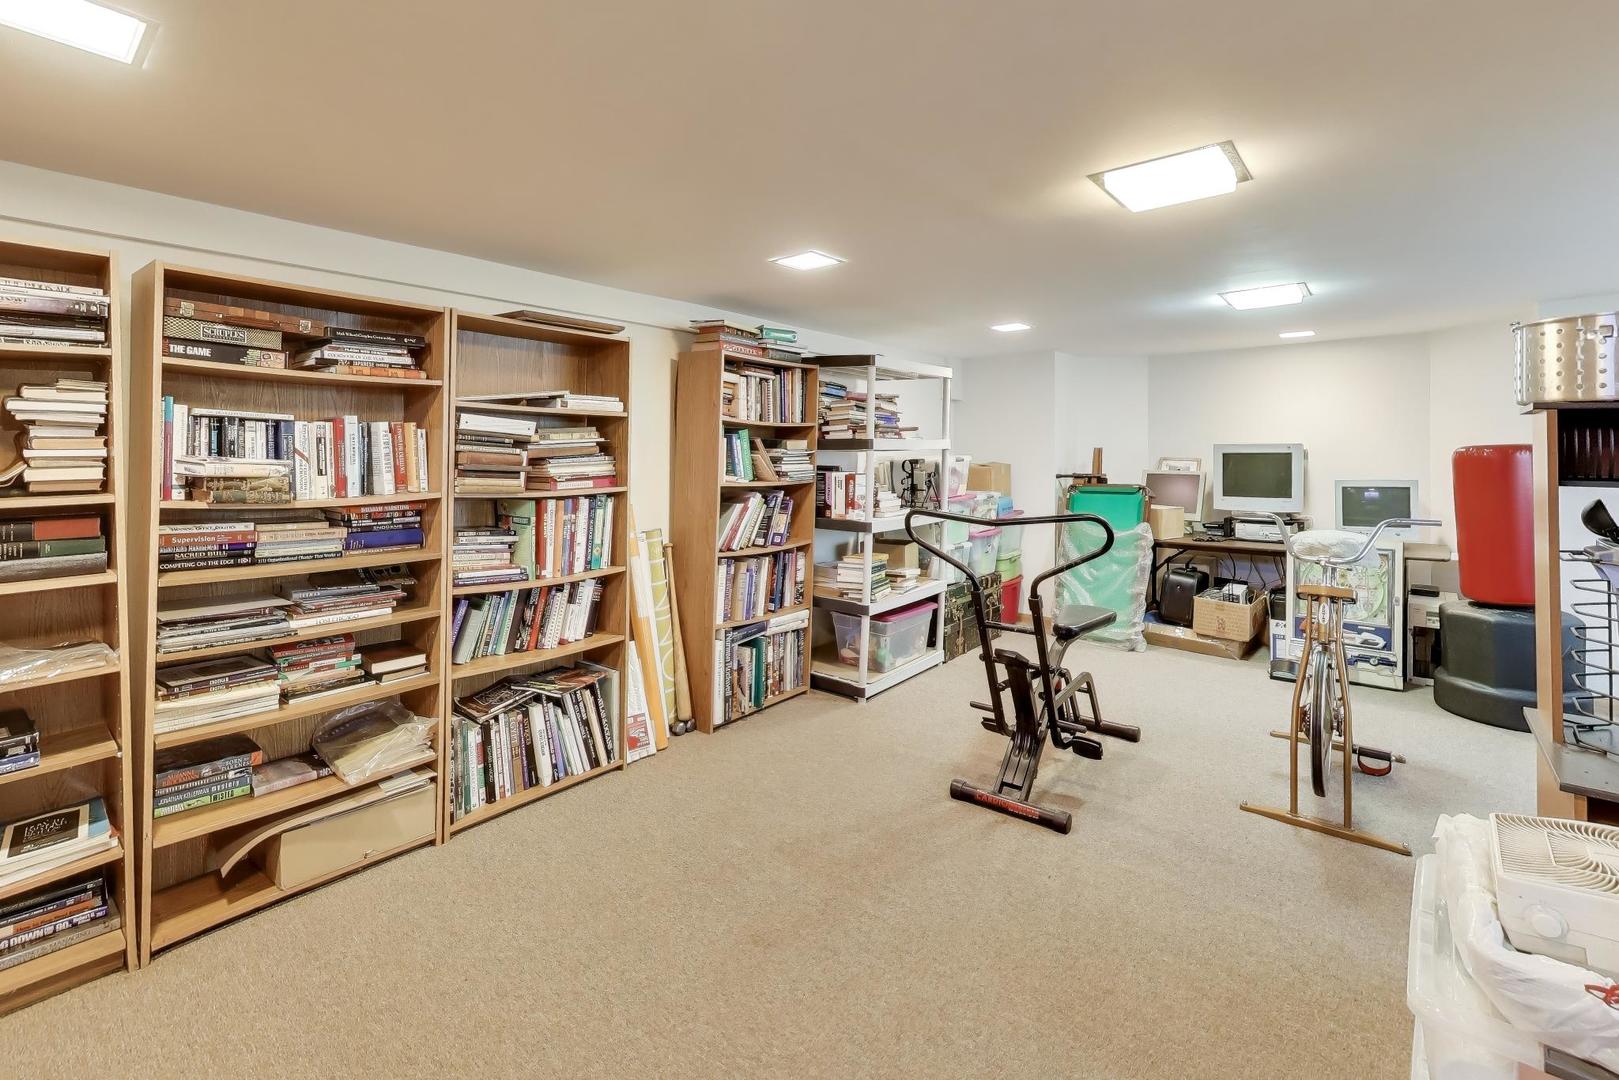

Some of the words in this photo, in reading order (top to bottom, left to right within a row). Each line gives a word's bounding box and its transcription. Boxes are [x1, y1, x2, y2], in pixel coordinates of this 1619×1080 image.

[204, 326, 244, 338] SCRUPLES
[169, 343, 185, 353] THE
[186, 346, 211, 356] GAME
[172, 536, 216, 544] Supervision
[174, 552, 206, 560] SACRED
[597, 697, 606, 718] ATLAS
[602, 724, 612, 749] OCEANS
[158, 794, 182, 806] JONATHAN
[183, 788, 210, 799] KELLERMAN
[212, 780, 240, 791] mystery
[10, 930, 43, 946] DOWN
